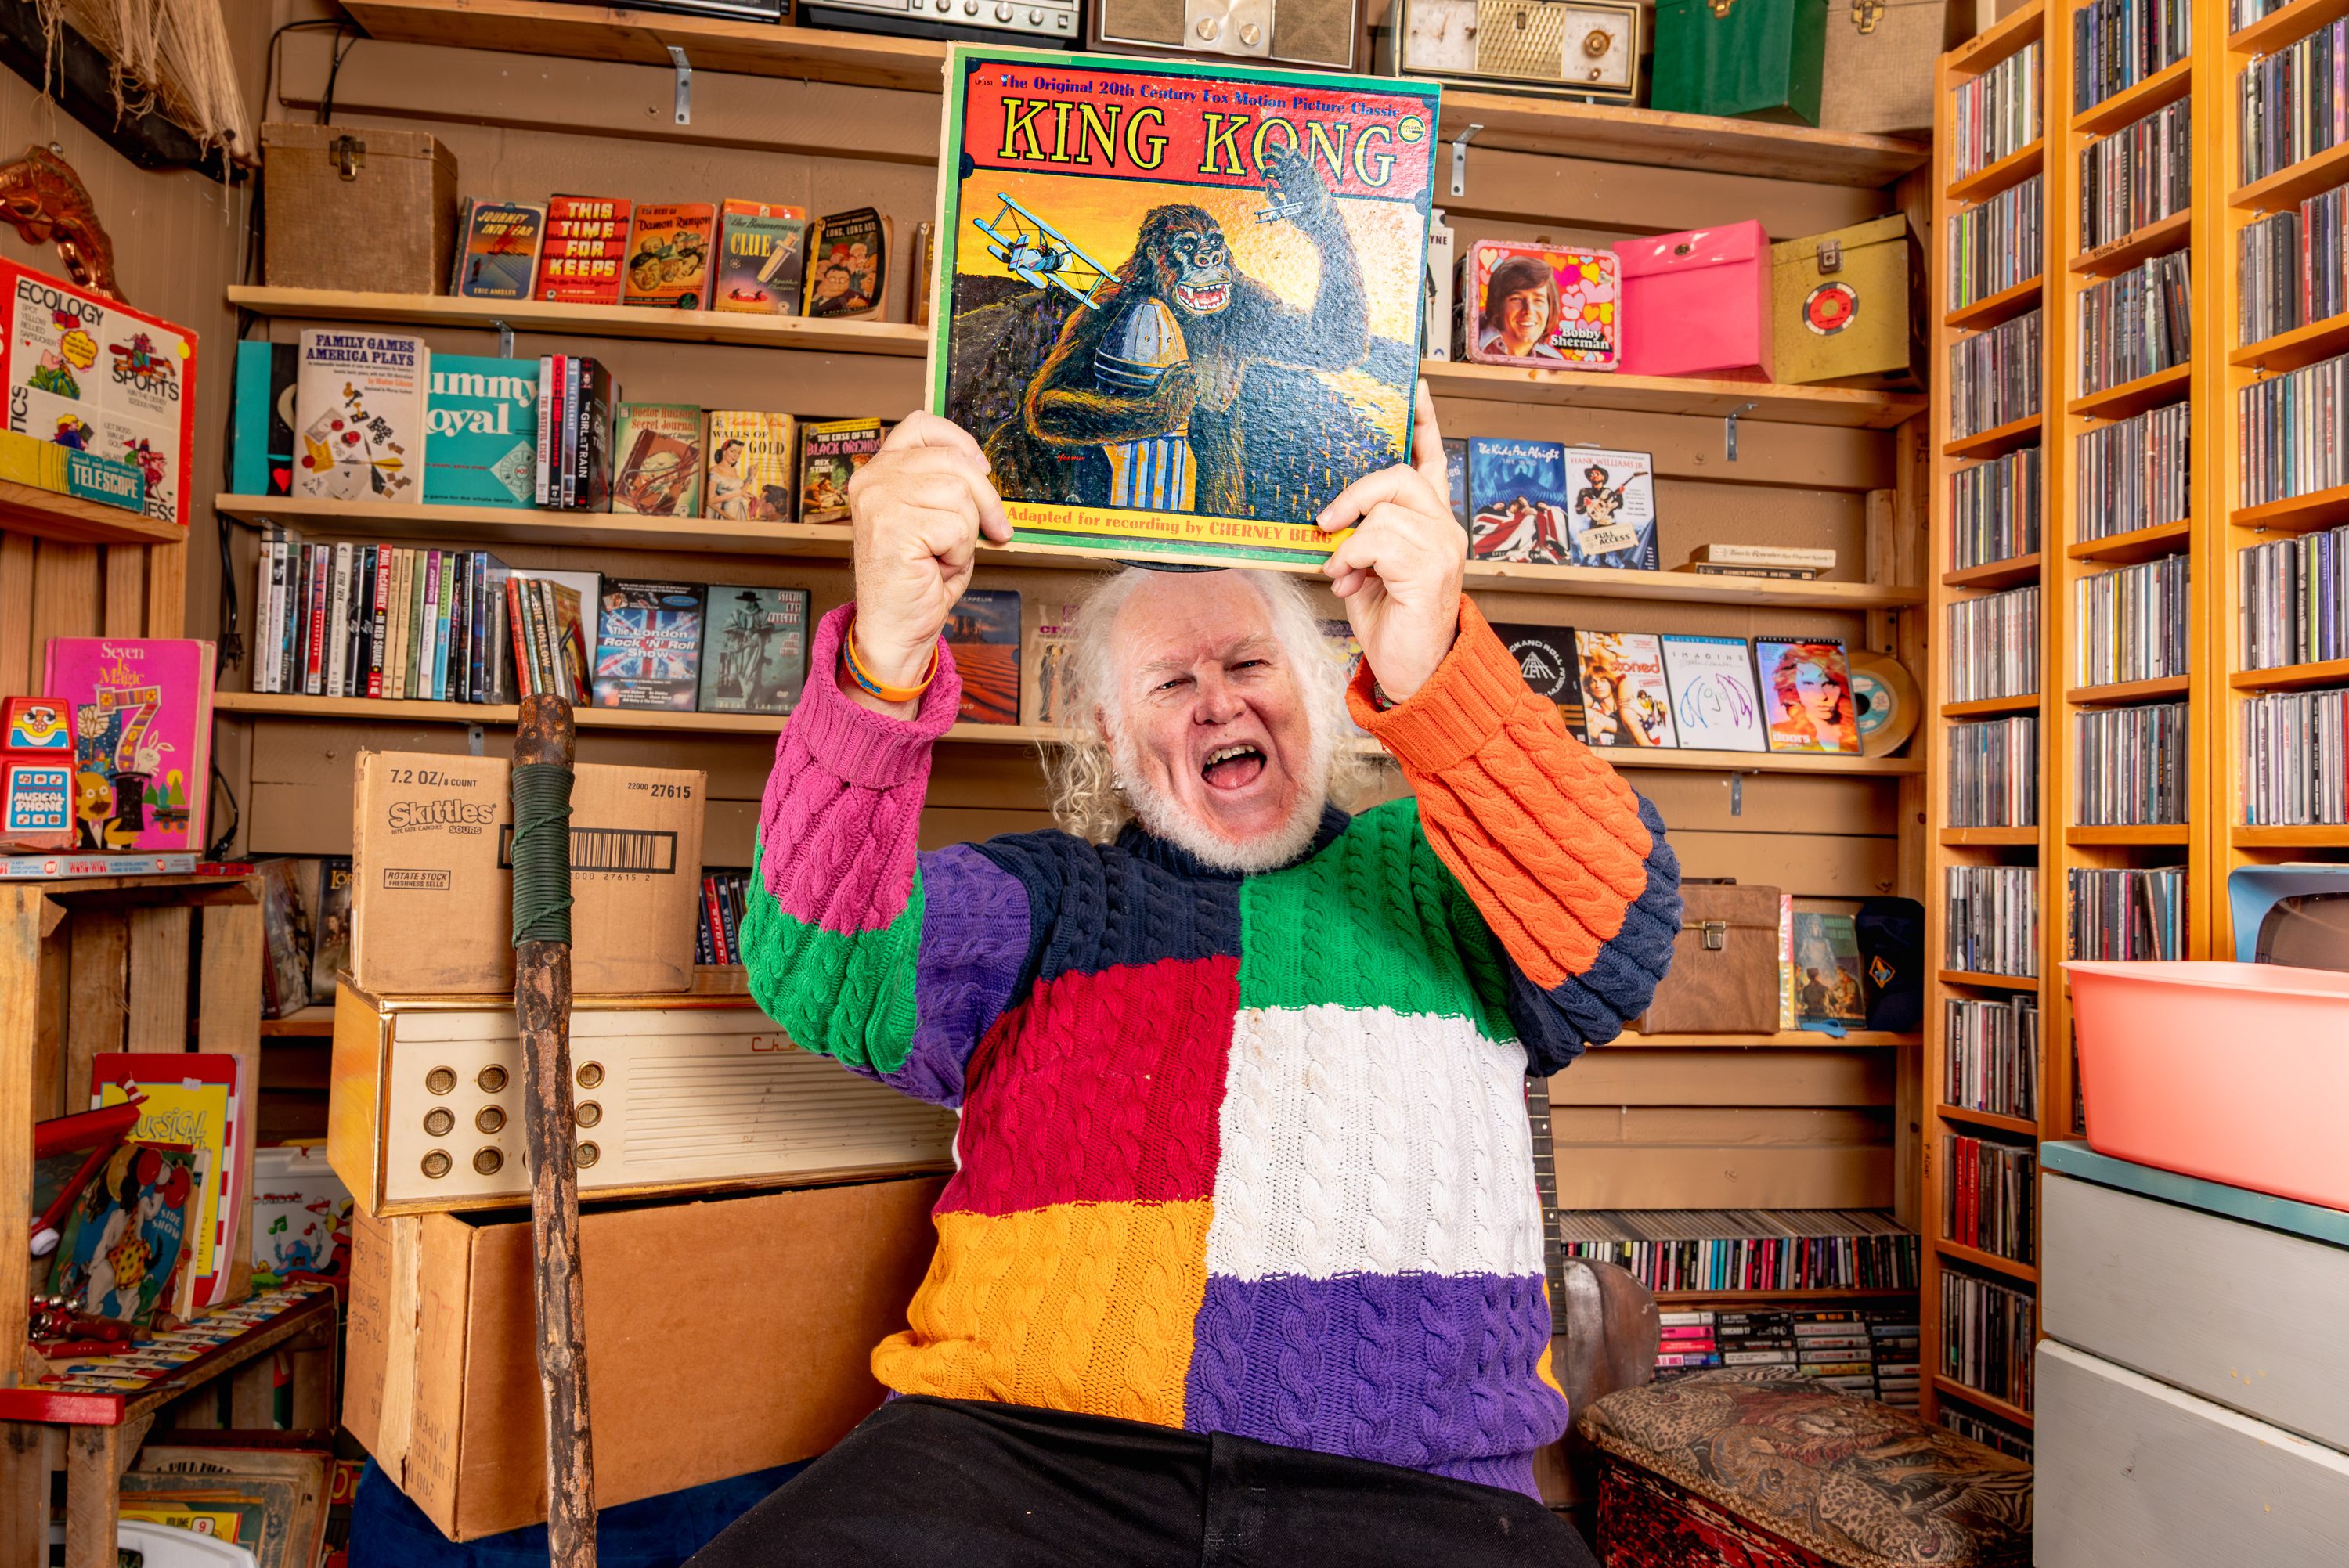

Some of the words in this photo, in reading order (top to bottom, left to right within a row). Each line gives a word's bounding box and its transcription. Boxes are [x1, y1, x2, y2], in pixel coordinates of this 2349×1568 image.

[1001, 74, 1028, 88] The
[1034, 76, 1093, 94] Original
[1099, 81, 1135, 96] 20th
[1140, 84, 1198, 103] Century
[1203, 89, 1229, 104] Fox
[1235, 92, 1286, 109] Motion
[1292, 96, 1345, 114] Picture
[1351, 102, 1400, 118] Classic
[997, 96, 1170, 171] KING
[1198, 111, 1398, 188] KONG
[477, 211, 529, 225] JOURNEY
[567, 201, 615, 219] THIS
[481, 224, 508, 236] INTO
[509, 225, 534, 237] FEAR
[560, 221, 615, 238] TIME
[637, 219, 673, 232] Damon
[674, 216, 712, 229] Runyon
[846, 224, 864, 235] LONG
[864, 222, 876, 232] AGO
[565, 240, 605, 258] FOR
[730, 232, 771, 258] CLUE
[549, 258, 617, 277] KEEPS
[489, 288, 517, 297] AMBLER
[17, 279, 104, 326] ECOLOGY
[1550, 334, 1611, 350] Sherman
[1560, 328, 1602, 341] Bobby
[316, 334, 365, 349] FAMILY
[367, 338, 415, 353] GAMES
[306, 348, 368, 363] AMERICA
[371, 351, 414, 366] PLAYS
[112, 365, 179, 402] SPORTS
[425, 403, 514, 438] oyal
[632, 406, 659, 418] Doctor
[580, 413, 590, 436] GIRL
[631, 419, 658, 430] Secret
[661, 420, 697, 431] Journal
[752, 431, 770, 439] OF
[831, 433, 850, 442] CASE
[862, 431, 875, 439] THE
[749, 440, 785, 456] GOLD
[806, 442, 840, 457] BLACK
[841, 437, 882, 454] ORCHIDS
[1478, 442, 1492, 455] The
[1492, 444, 1513, 457] Kids
[1513, 445, 1528, 457] Are
[1527, 446, 1561, 463] Alright
[579, 443, 589, 478] TRAIN
[1571, 456, 1594, 465] HANK
[1597, 458, 1633, 468] WILLIAMS
[809, 465, 835, 474] STOUT
[72, 463, 139, 499] TELESCOPE
[1007, 506, 1073, 527] Adapted
[1077, 511, 1101, 527] for
[1105, 516, 1180, 535] recording
[1185, 520, 1203, 537] by
[1208, 521, 1286, 540] CHERNEY
[1289, 528, 1333, 545] BERG
[1594, 531, 1615, 539] FULL
[1599, 534, 1631, 546] ACCESS
[379, 549, 390, 567] PAUL
[337, 571, 346, 585] STAR
[336, 587, 345, 601] TREK
[375, 568, 389, 609] McCARTNEY
[377, 615, 385, 625] IN
[374, 625, 384, 639] RED
[612, 626, 630, 636] The
[633, 628, 688, 639] London
[101, 641, 144, 660] Seven
[537, 622, 550, 668] HOLLOW
[603, 637, 640, 647] Rock
[667, 640, 695, 651] Roll
[371, 640, 383, 668] SQUARE
[626, 647, 669, 659] Show
[1543, 643, 1563, 666] ROLL
[1672, 651, 1744, 661] IMAGINE
[117, 658, 130, 674] Is
[1609, 654, 1661, 674] stoned
[99, 667, 145, 687] Magic
[390, 769, 413, 784] 7.2
[450, 779, 478, 788] COUNT
[13, 792, 65, 802] MUSICAL
[627, 782, 649, 791] 22000
[651, 784, 691, 799] 27615
[14, 801, 63, 813] PHONE
[388, 798, 494, 828] Skittles
[448, 825, 482, 835] SOURS
[388, 871, 419, 881] ROTATE
[420, 872, 448, 881] STOCK
[603, 873, 637, 881] 27615
[723, 907, 736, 950] WONDER
[160, 1208, 182, 1226] SIDE
[151, 1218, 181, 1241] SHOW
[166, 1516, 190, 1526] VOLUME
[198, 1520, 207, 1533] 9
